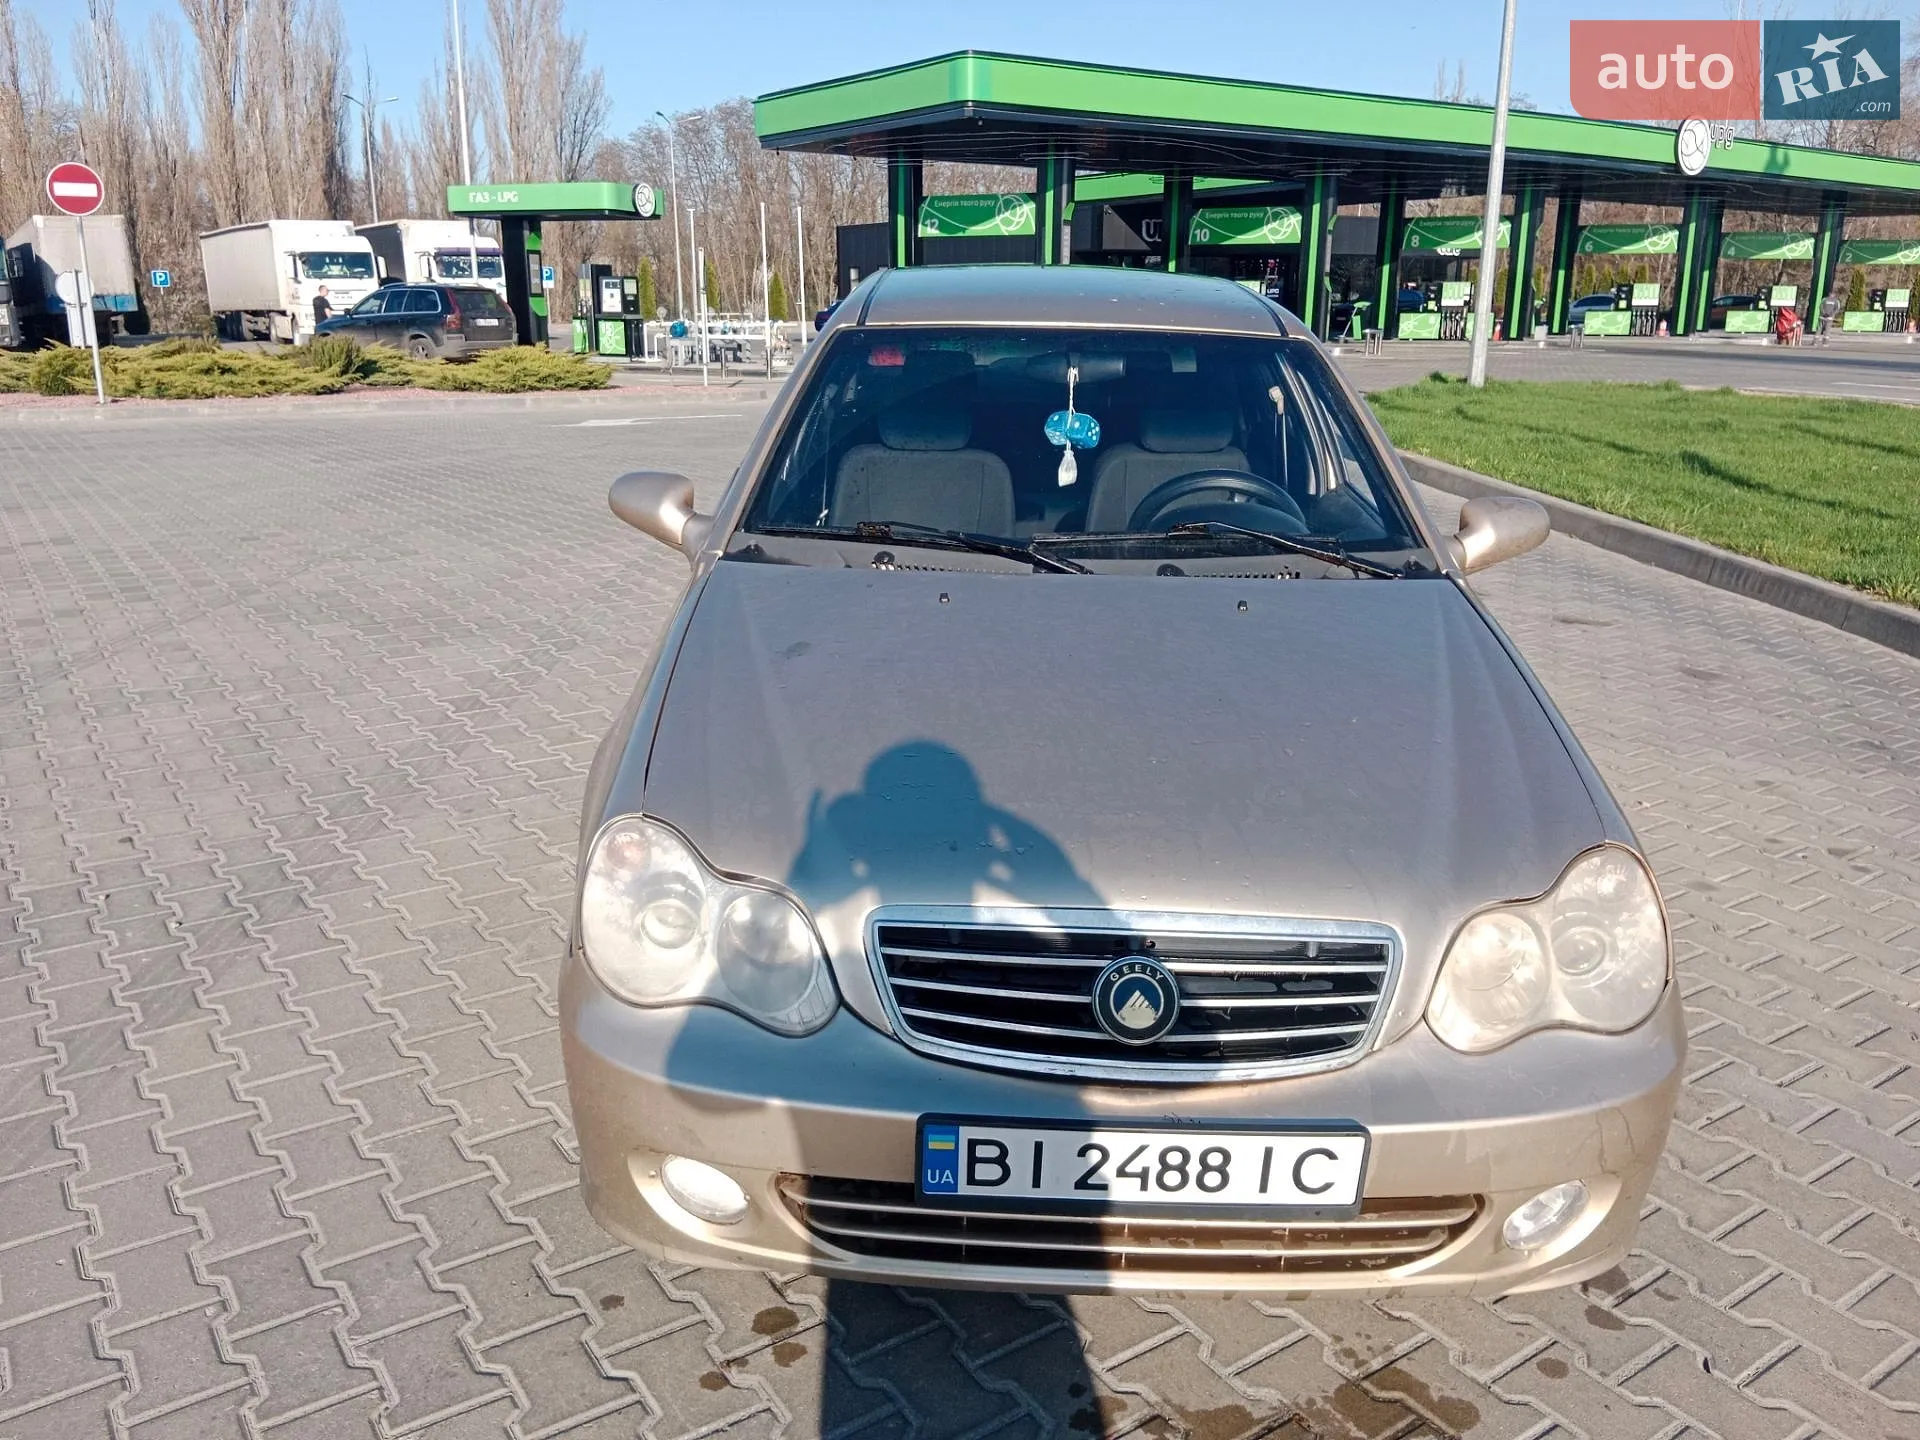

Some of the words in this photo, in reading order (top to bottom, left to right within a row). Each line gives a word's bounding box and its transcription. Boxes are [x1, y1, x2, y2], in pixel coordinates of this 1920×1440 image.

[924, 218, 940, 234] 12
[1194, 228, 1210, 242] 10
[1411, 235, 1420, 248] 8
[1585, 241, 1593, 252] 6
[1727, 246, 1736, 256] 4
[1845, 252, 1853, 262] 2
[1110, 964, 1164, 982] GEELY
[966, 1137, 1044, 1190] BI
[1073, 1142, 1232, 1194] 2488
[1258, 1146, 1339, 1195] IC
[927, 1168, 954, 1185] UA
